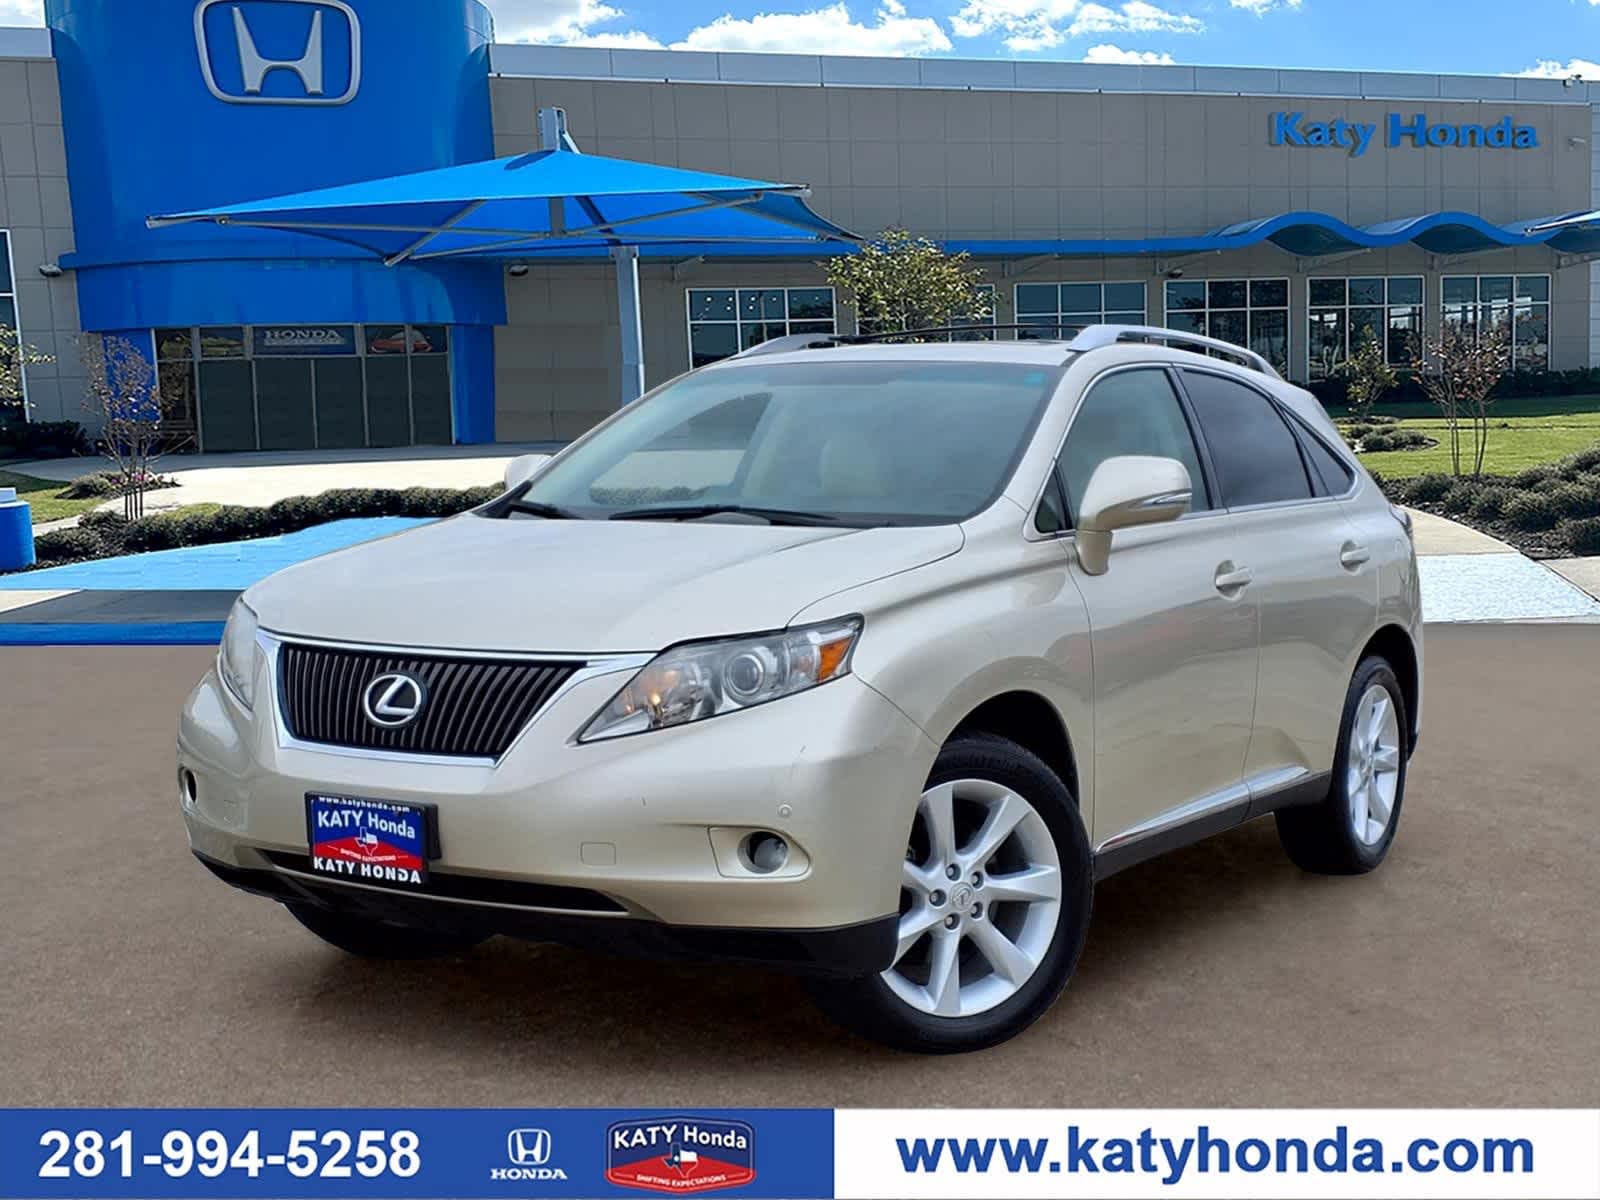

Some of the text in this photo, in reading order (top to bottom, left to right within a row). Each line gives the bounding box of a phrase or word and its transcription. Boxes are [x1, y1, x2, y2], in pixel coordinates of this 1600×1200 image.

[1271, 111, 1540, 157] Katy Honda
[264, 329, 341, 339] HONDA
[319, 796, 410, 813] www.katyhonda.com
[317, 809, 416, 839] KATY Honda
[313, 856, 422, 884] KATY HONDA
